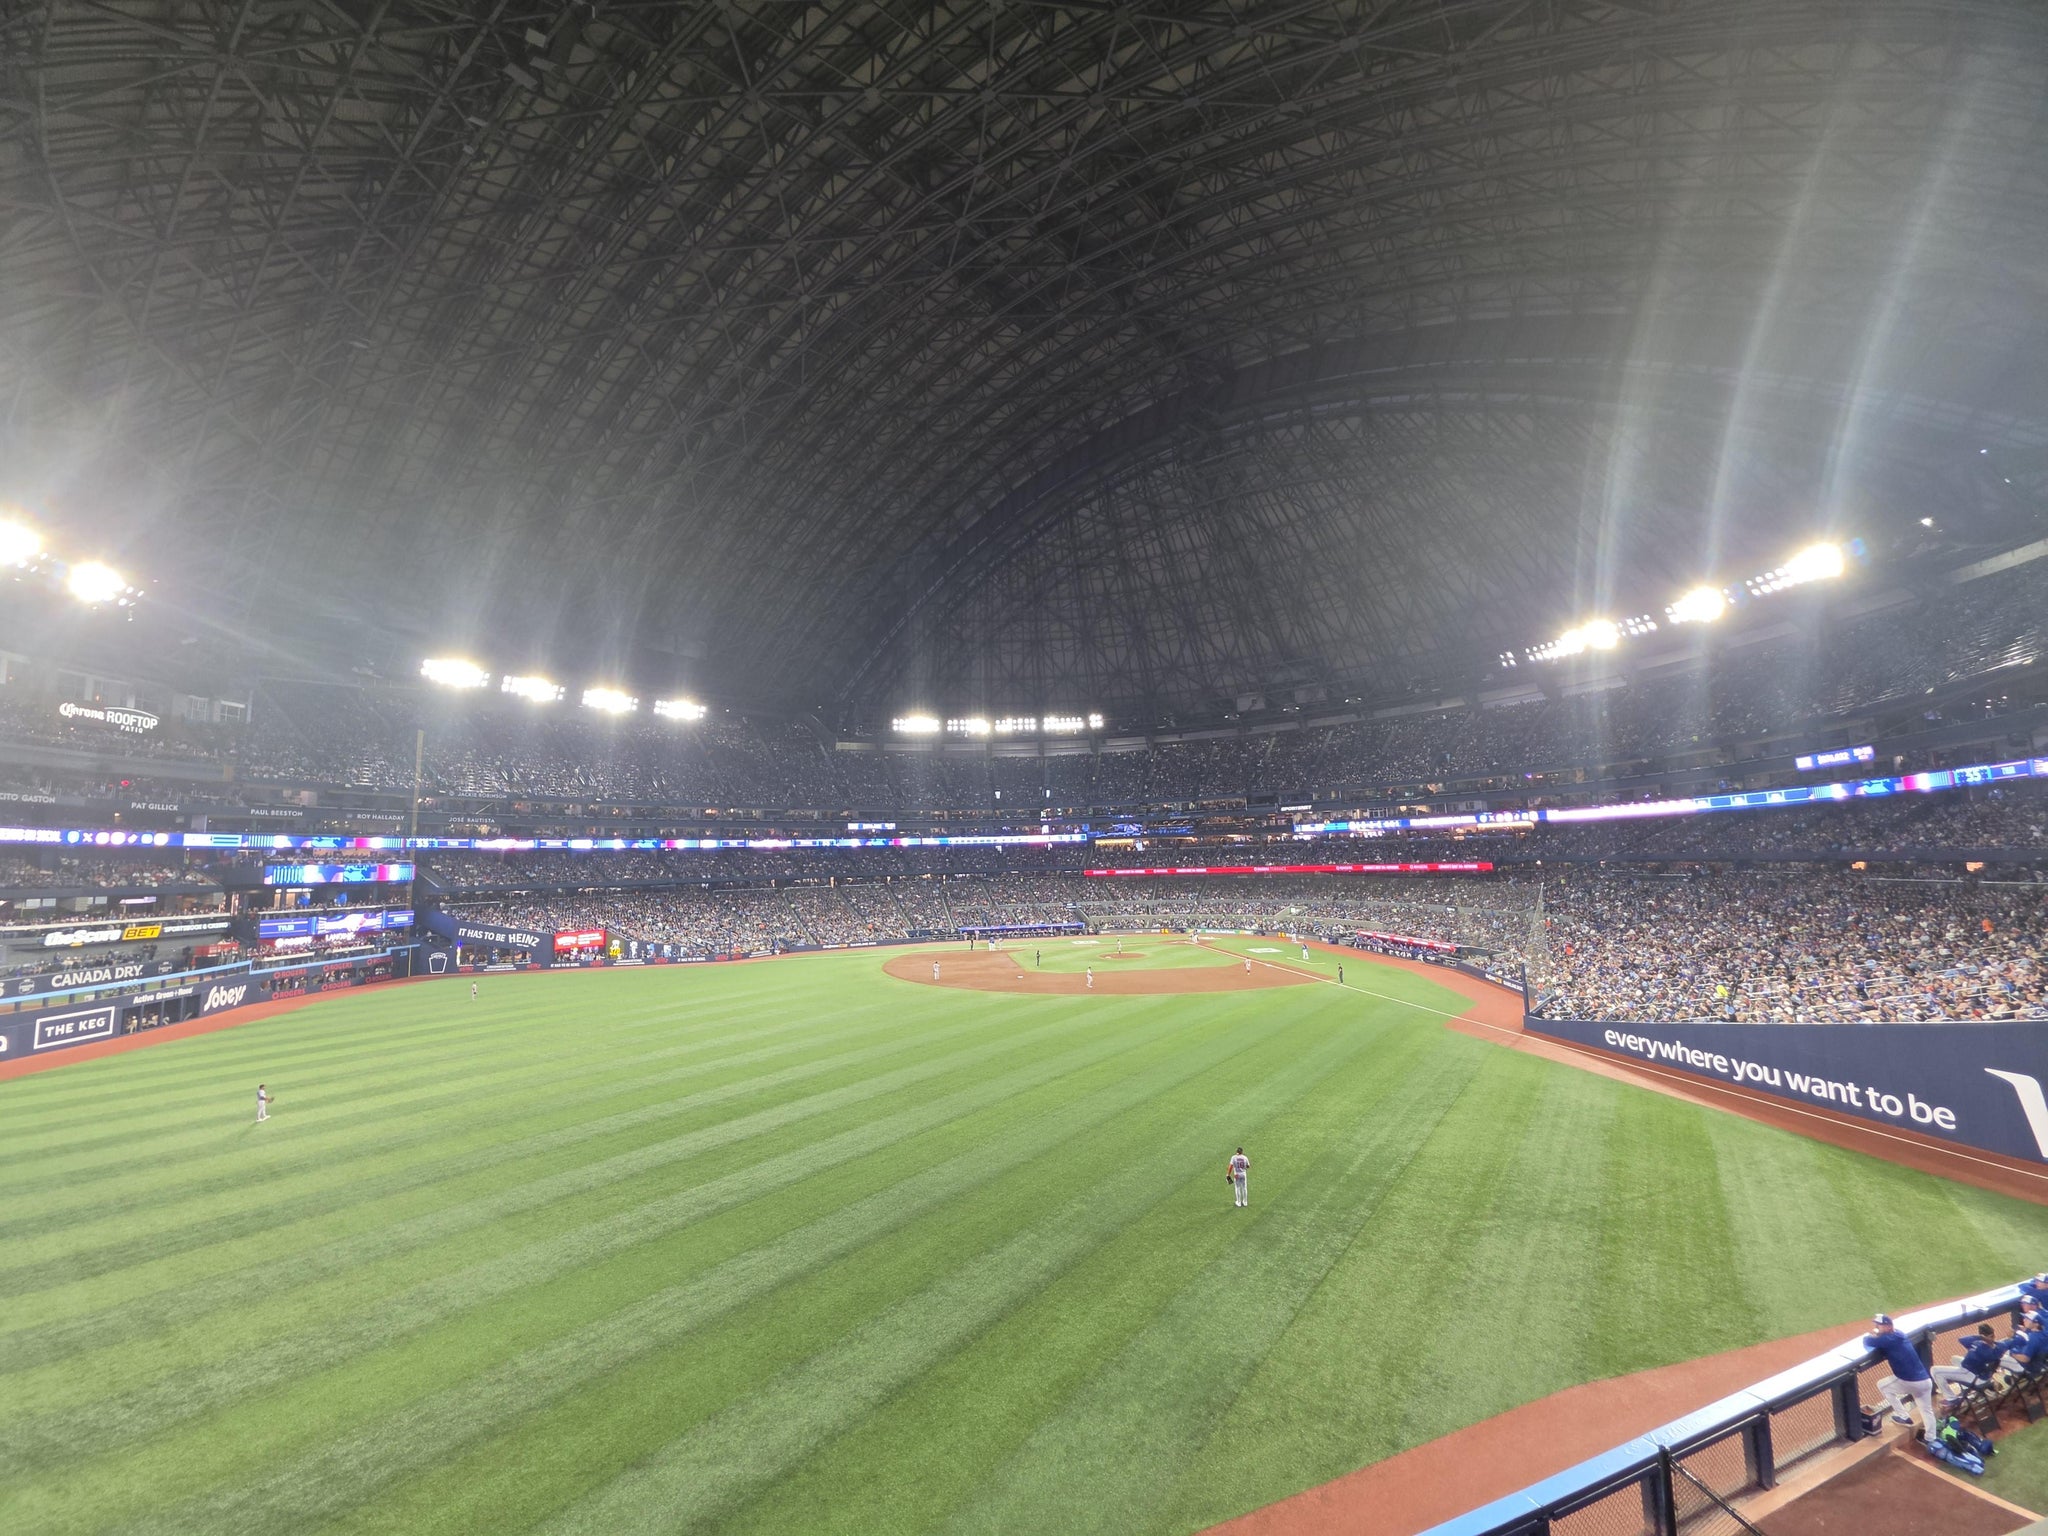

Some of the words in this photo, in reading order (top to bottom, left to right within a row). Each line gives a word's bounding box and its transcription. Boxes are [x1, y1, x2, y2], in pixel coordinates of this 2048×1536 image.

[59, 702, 105, 720] Corona
[106, 710, 158, 729] ROOFTOP
[120, 725, 143, 734] PATIO
[22, 794, 56, 803] GASTON
[131, 802, 146, 810] PAT
[250, 808, 269, 816] PAUL
[164, 924, 202, 932] SPORTSBOOK
[44, 930, 121, 946] theScore
[125, 927, 159, 938] BET
[458, 928, 467, 937] IT
[467, 929, 483, 939] HAS
[484, 931, 494, 940] TO
[495, 933, 506, 942] BE
[508, 933, 540, 947] HEINZ
[330, 962, 352, 970] ROGERS
[51, 968, 112, 988] CANADA
[281, 968, 307, 978] ROGERS
[328, 980, 351, 989] ROGERS
[203, 984, 247, 1012] Sobeys
[280, 988, 305, 998] ROGERS
[133, 994, 154, 1004] Active
[45, 1022, 74, 1038] THE
[78, 1017, 106, 1031] KEG
[1604, 1028, 1730, 1074] everywhere
[1731, 1057, 1782, 1087] you
[1784, 1066, 1862, 1108] want
[1865, 1086, 1904, 1118] to
[1908, 1093, 1957, 1131] be
